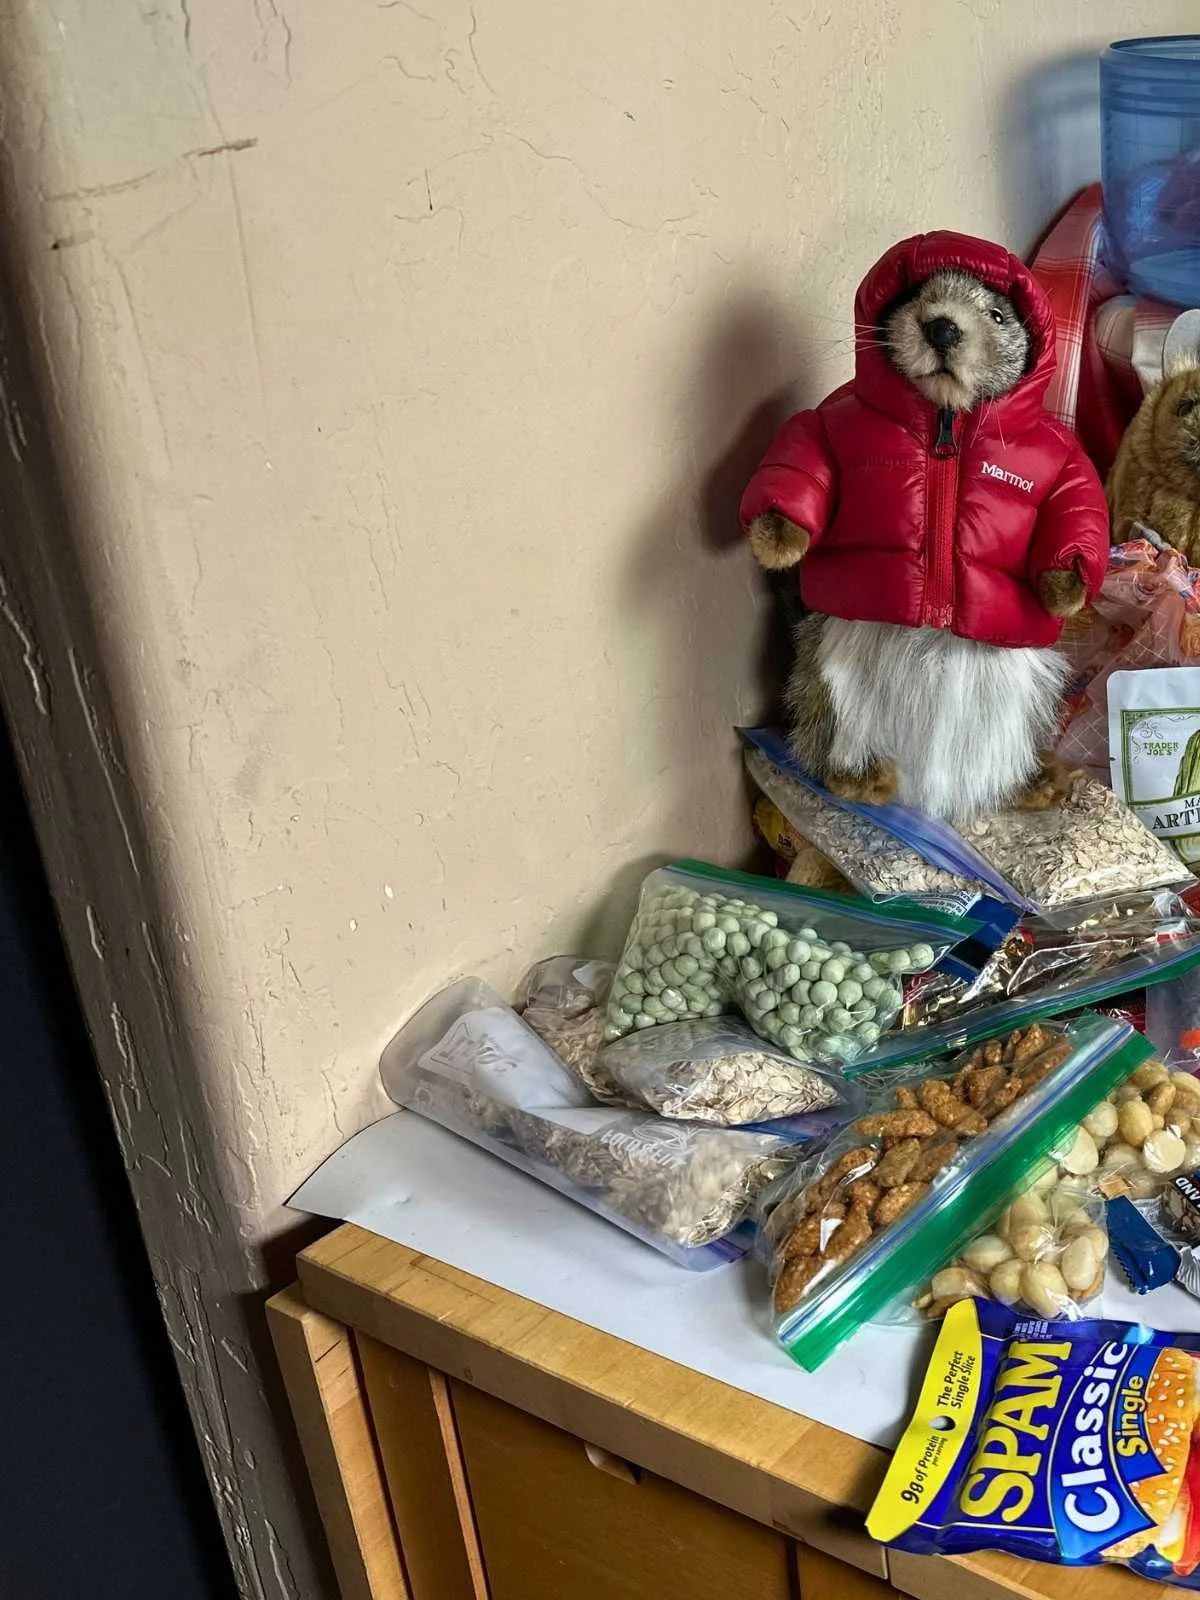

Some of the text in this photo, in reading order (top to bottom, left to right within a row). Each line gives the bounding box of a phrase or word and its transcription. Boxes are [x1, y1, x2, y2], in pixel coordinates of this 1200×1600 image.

[981, 461, 1034, 493] Marmot
[1143, 742, 1179, 750] TRADER
[936, 1350, 964, 1408] The Perfect
[951, 1355, 976, 1409] Single Slice
[959, 1340, 1073, 1523] SPAM
[1062, 1340, 1130, 1532] Classic
[1115, 1375, 1148, 1459] Single
[900, 1435, 940, 1505] 9g of Protein
